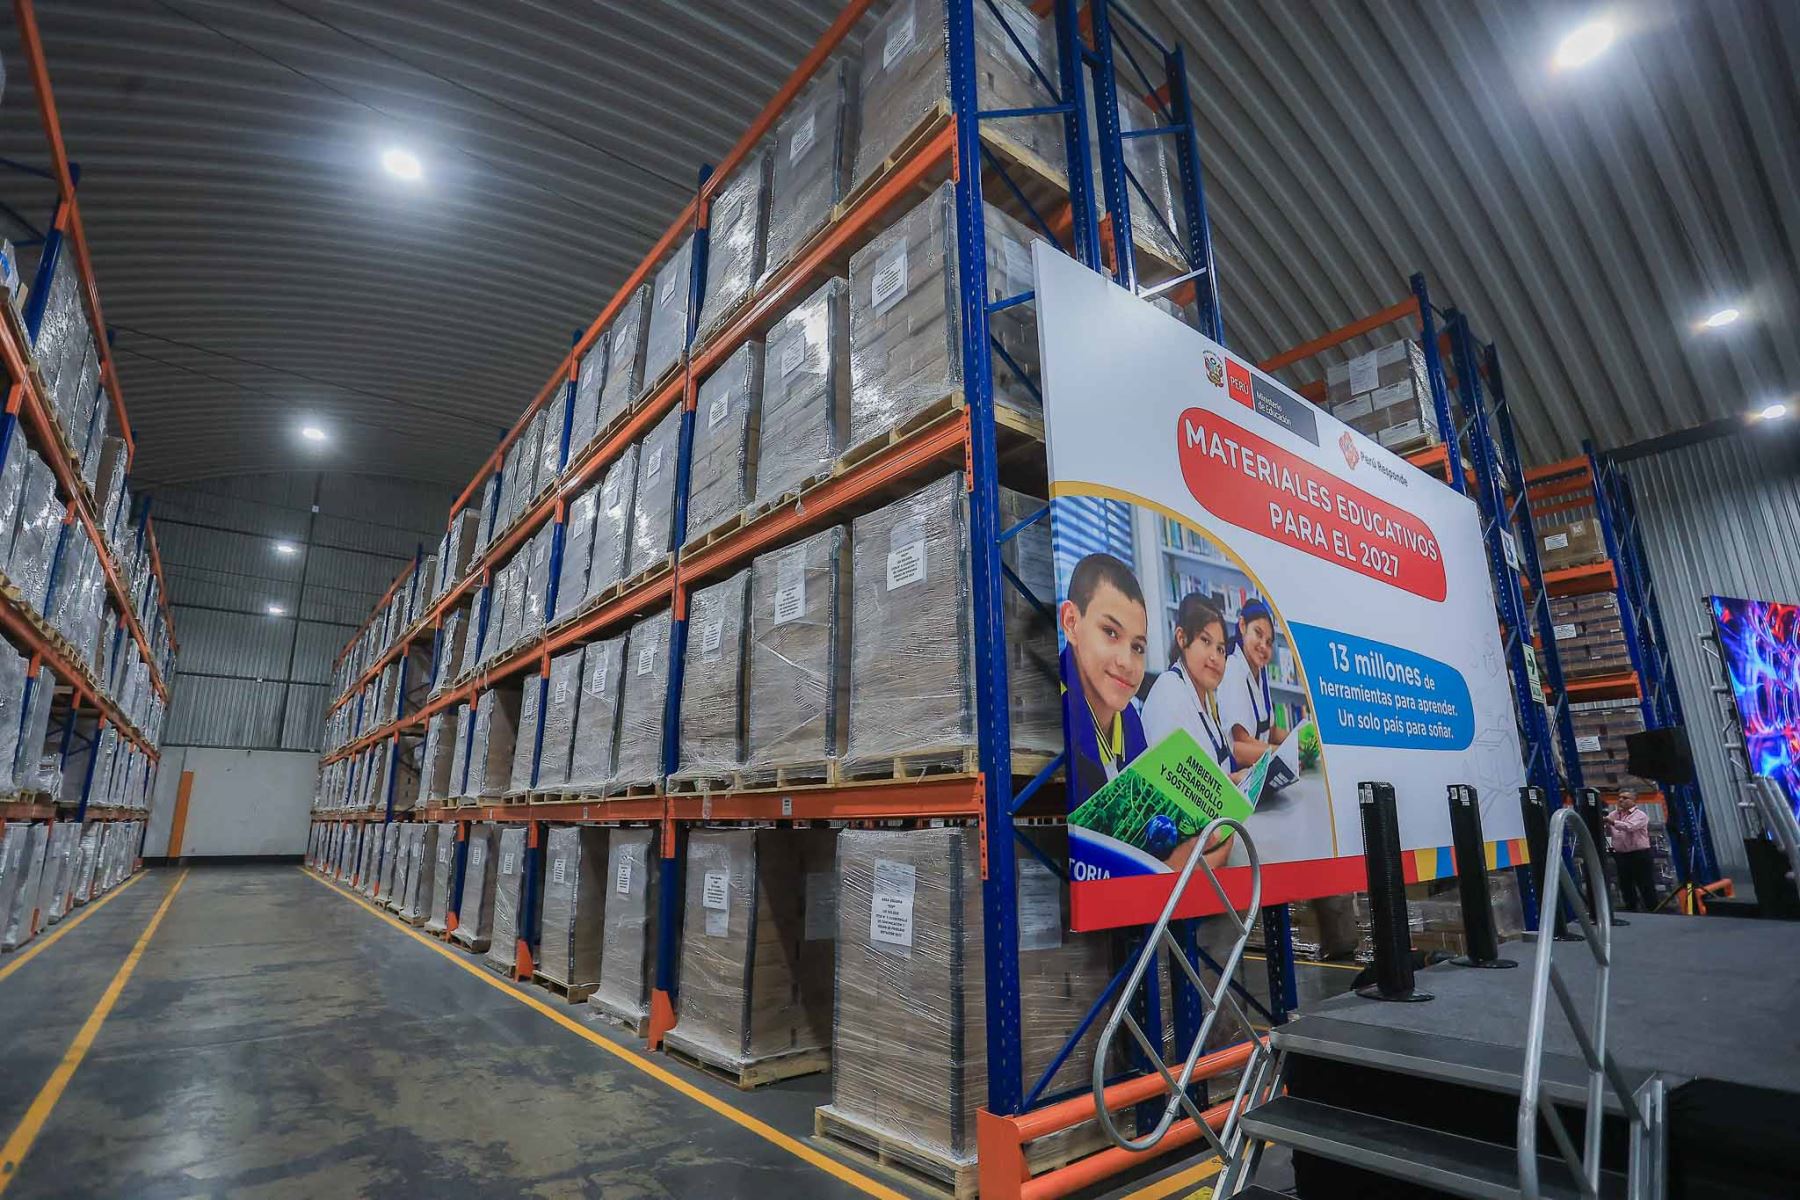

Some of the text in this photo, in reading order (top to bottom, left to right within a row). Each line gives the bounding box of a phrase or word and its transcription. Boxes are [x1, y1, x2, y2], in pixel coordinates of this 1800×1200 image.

[1185, 418, 1438, 561] MATERIALES EDUCATIVOS
[1269, 501, 1399, 578] PARA EL 2027
[1329, 641, 1436, 691] 13 millones de
[1319, 676, 1458, 717] herramientas para aprender.
[1338, 708, 1355, 728] Un
[1357, 712, 1381, 731] solo
[1405, 721, 1427, 737] para
[1428, 721, 1454, 740] soñar.
[1160, 764, 1222, 820] Y SOSTENIBILIDA
[1176, 762, 1223, 810] DESARROLLO
[1186, 755, 1222, 797] AMBIENTE,
